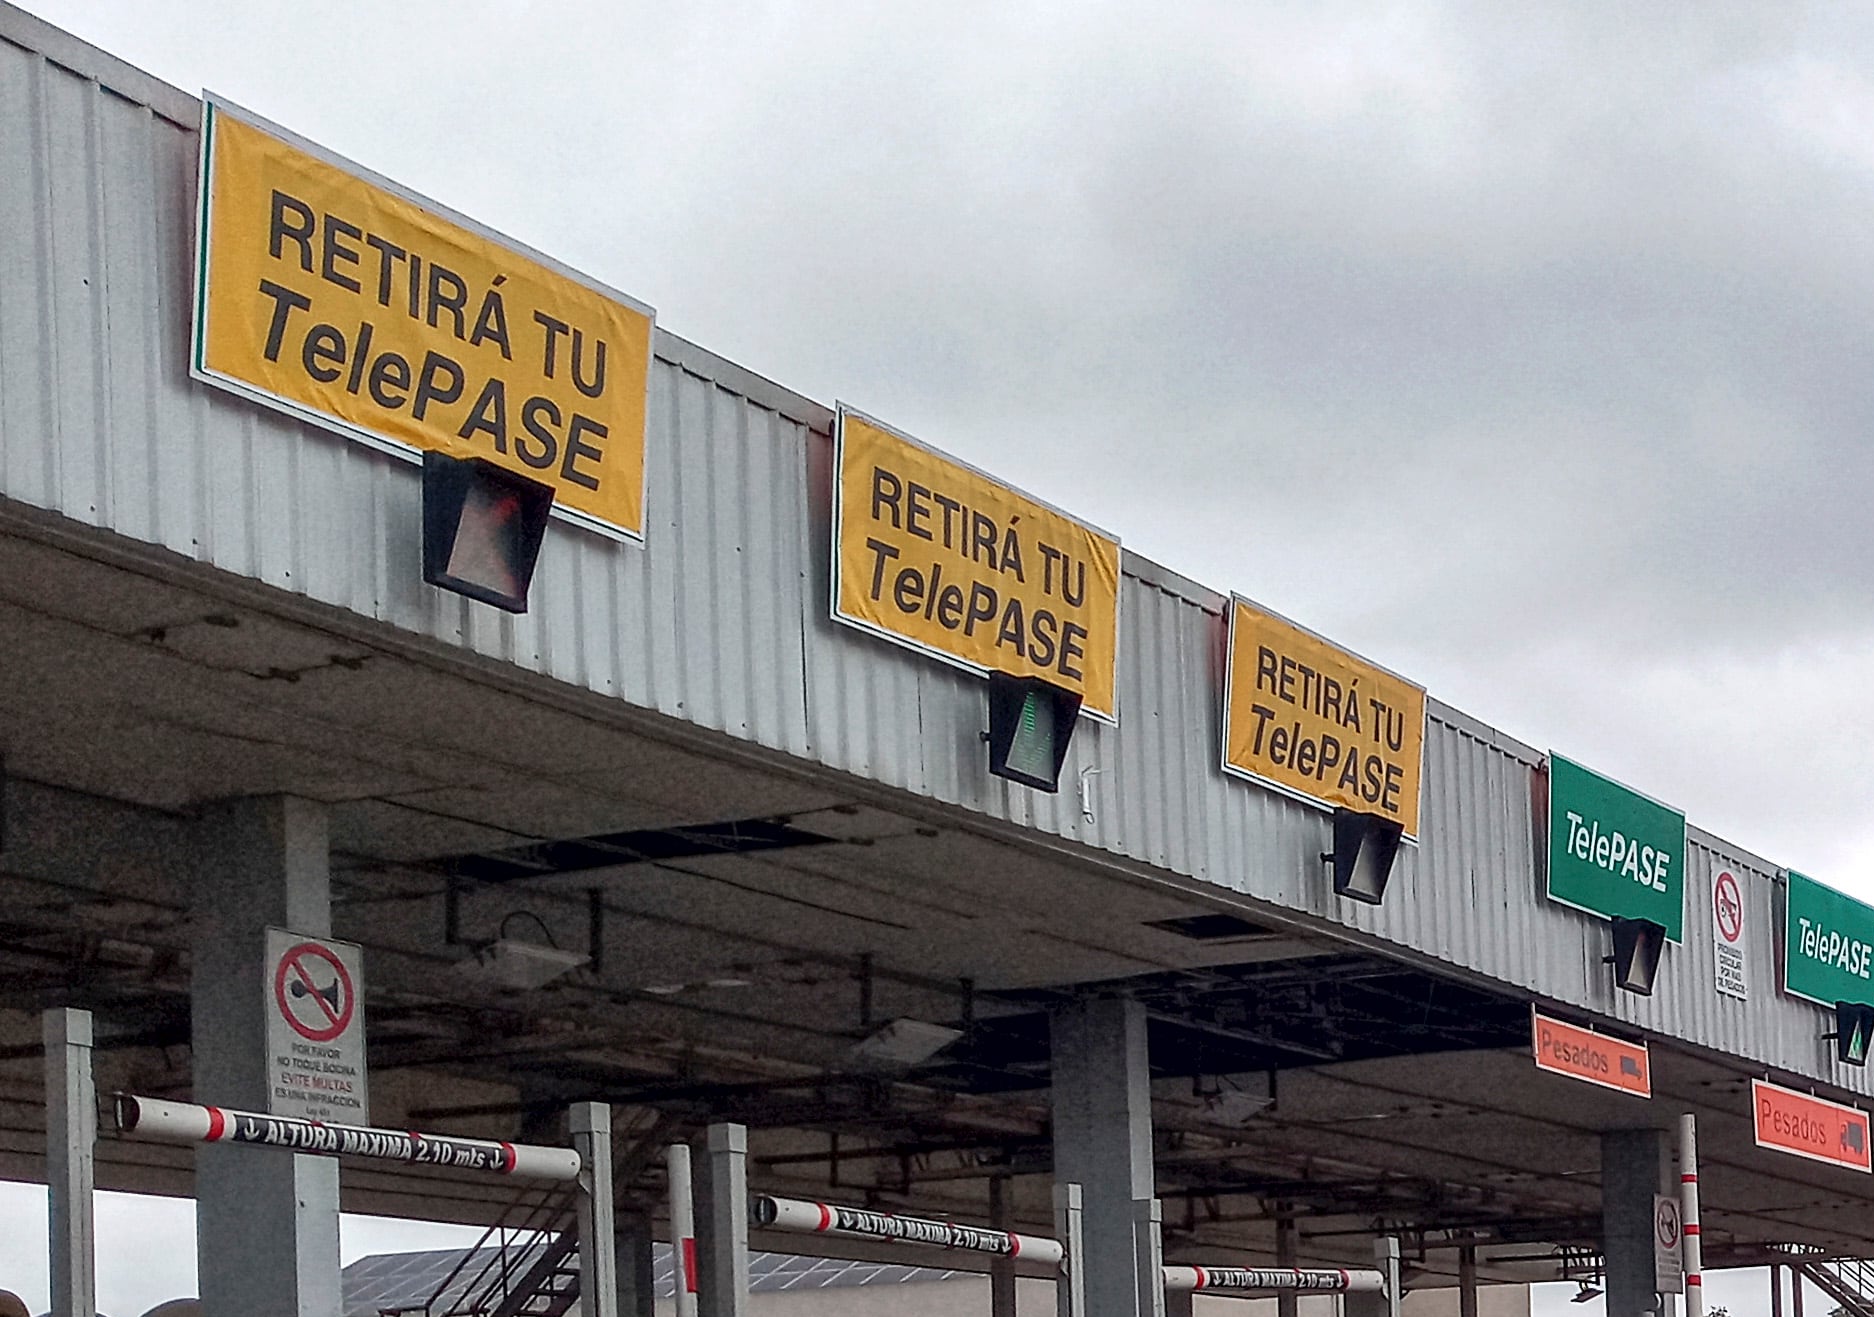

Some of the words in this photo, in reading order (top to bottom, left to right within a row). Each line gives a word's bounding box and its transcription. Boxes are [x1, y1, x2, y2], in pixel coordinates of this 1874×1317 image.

[268, 187, 514, 361] RETIRÁ
[533, 309, 607, 399] TU
[258, 278, 609, 493] TelePASE
[872, 465, 1025, 584] RETIRÁ
[1037, 546, 1086, 608] TU
[866, 536, 1089, 682] TelePASE
[1256, 645, 1362, 735] RETIRÁ
[1368, 697, 1405, 752] TU
[1250, 705, 1405, 814] TelePASE
[1566, 811, 1671, 893] TelePASE
[1798, 917, 1873, 980] TelePASE
[281, 1072, 310, 1087] EVITE
[312, 1074, 353, 1093] MULTAS
[1541, 1028, 1609, 1076] Pesados
[264, 1119, 338, 1151] ALTURA
[342, 1130, 413, 1160] MAXIMA
[416, 1139, 452, 1166] 2.10
[455, 1149, 486, 1169] mts
[1761, 1098, 1828, 1147] Pesados
[856, 1213, 903, 1237] ALTURA
[905, 1220, 952, 1245] MAXIMA
[978, 1235, 999, 1251] mts
[1222, 1270, 1260, 1288] ALTURA
[1261, 1272, 1298, 1288] MAXIMA
